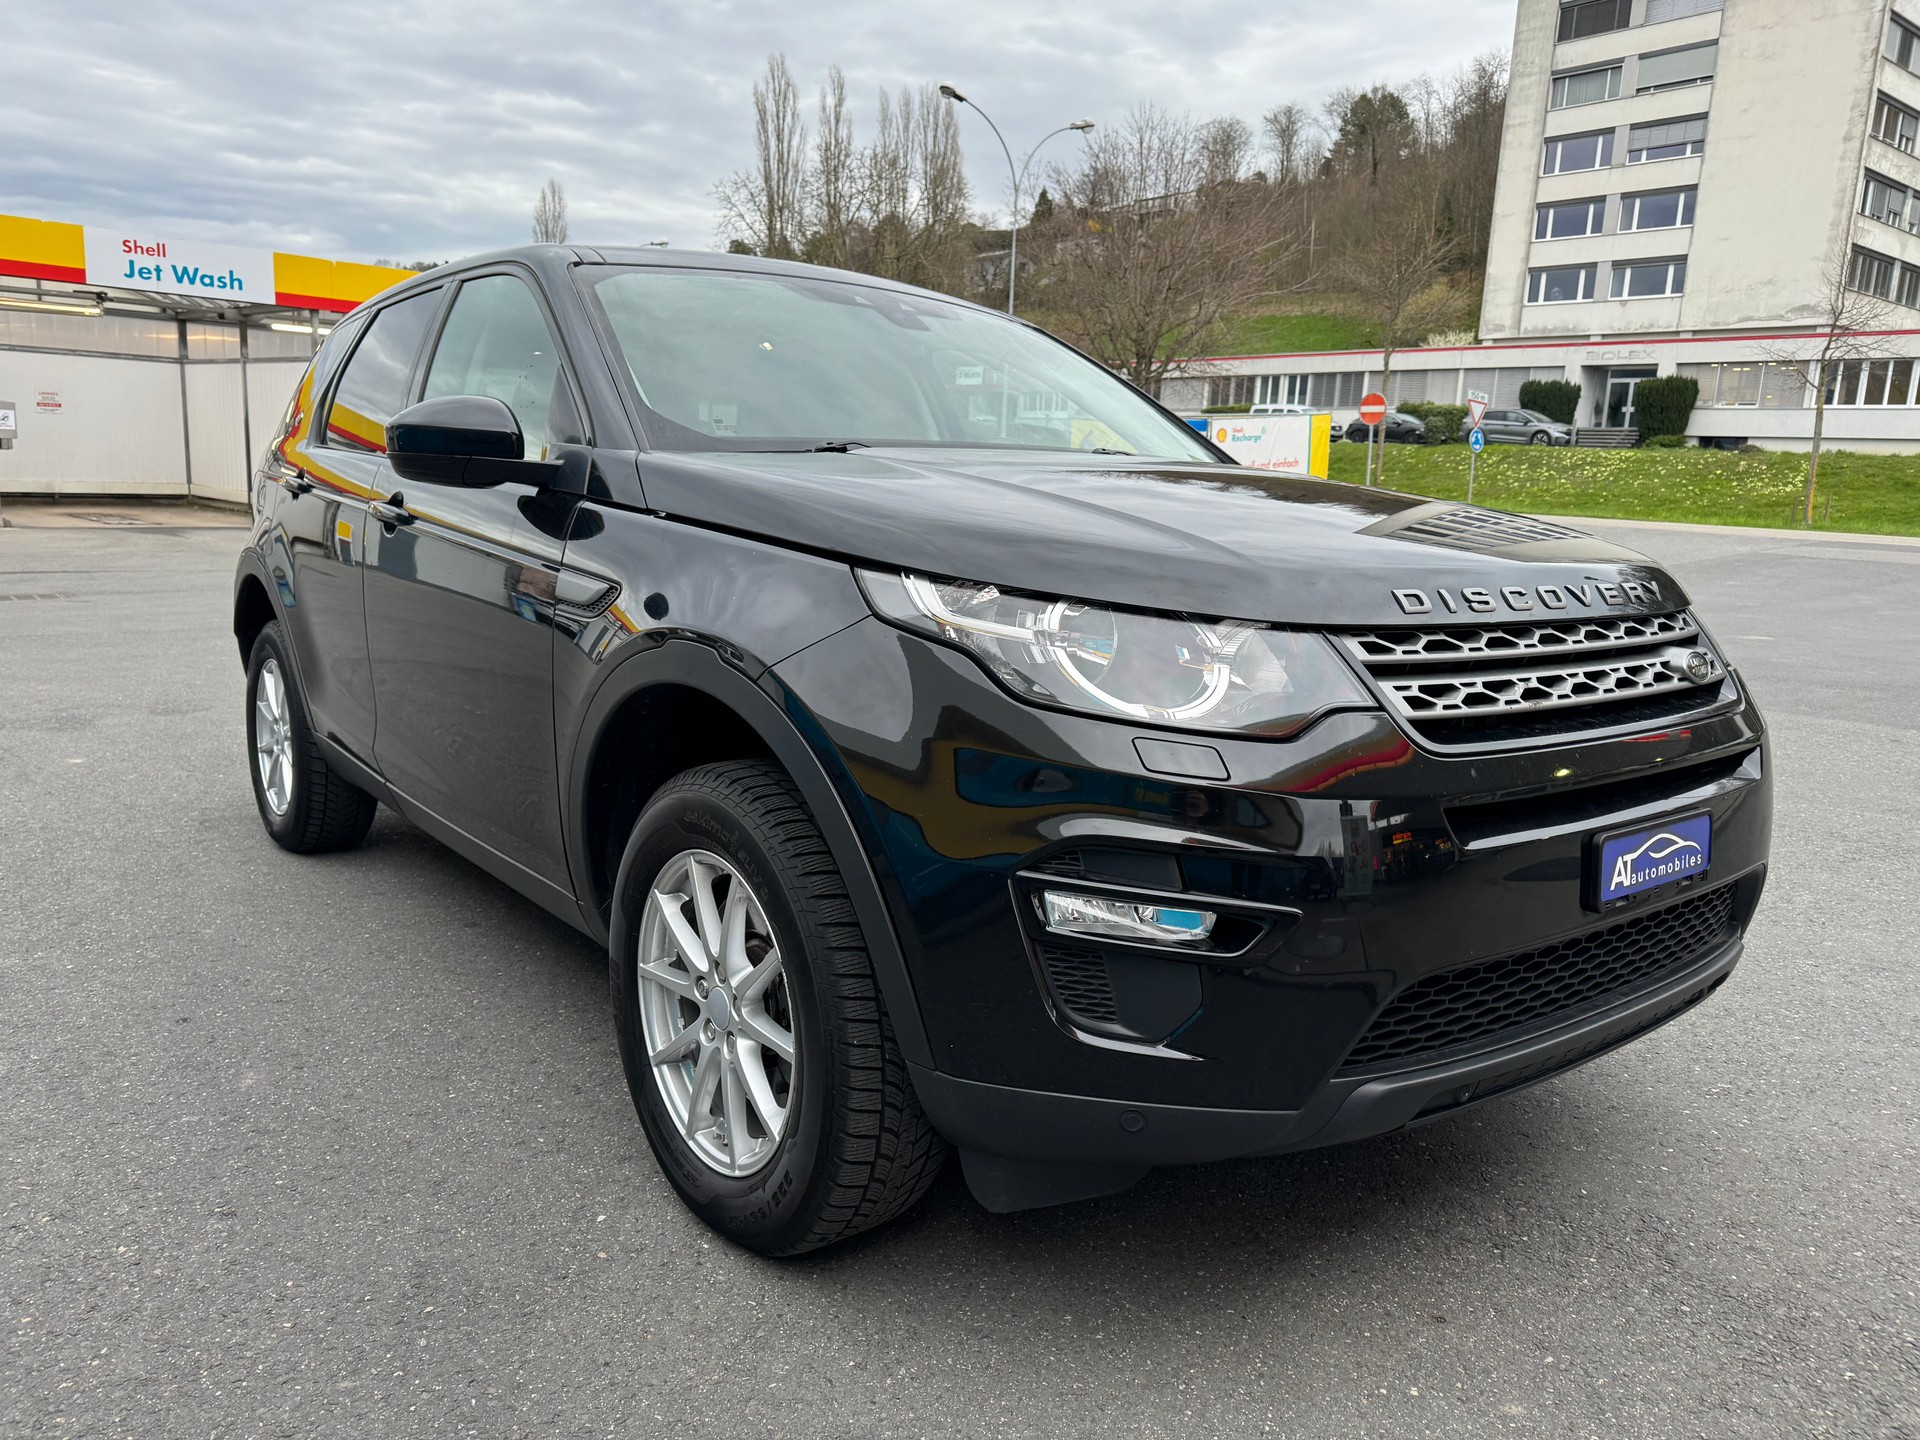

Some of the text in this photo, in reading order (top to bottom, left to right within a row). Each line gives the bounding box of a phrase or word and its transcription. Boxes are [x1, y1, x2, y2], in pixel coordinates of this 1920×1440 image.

[122, 239, 166, 258] Shell
[123, 259, 244, 291] Jet Wash
[1585, 349, 1657, 361] BOLEX
[1231, 433, 1262, 443] Recharge
[1273, 457, 1299, 469] einfach
[1391, 580, 1663, 614] DISCOVERY
[1631, 854, 1702, 884] automobiles
